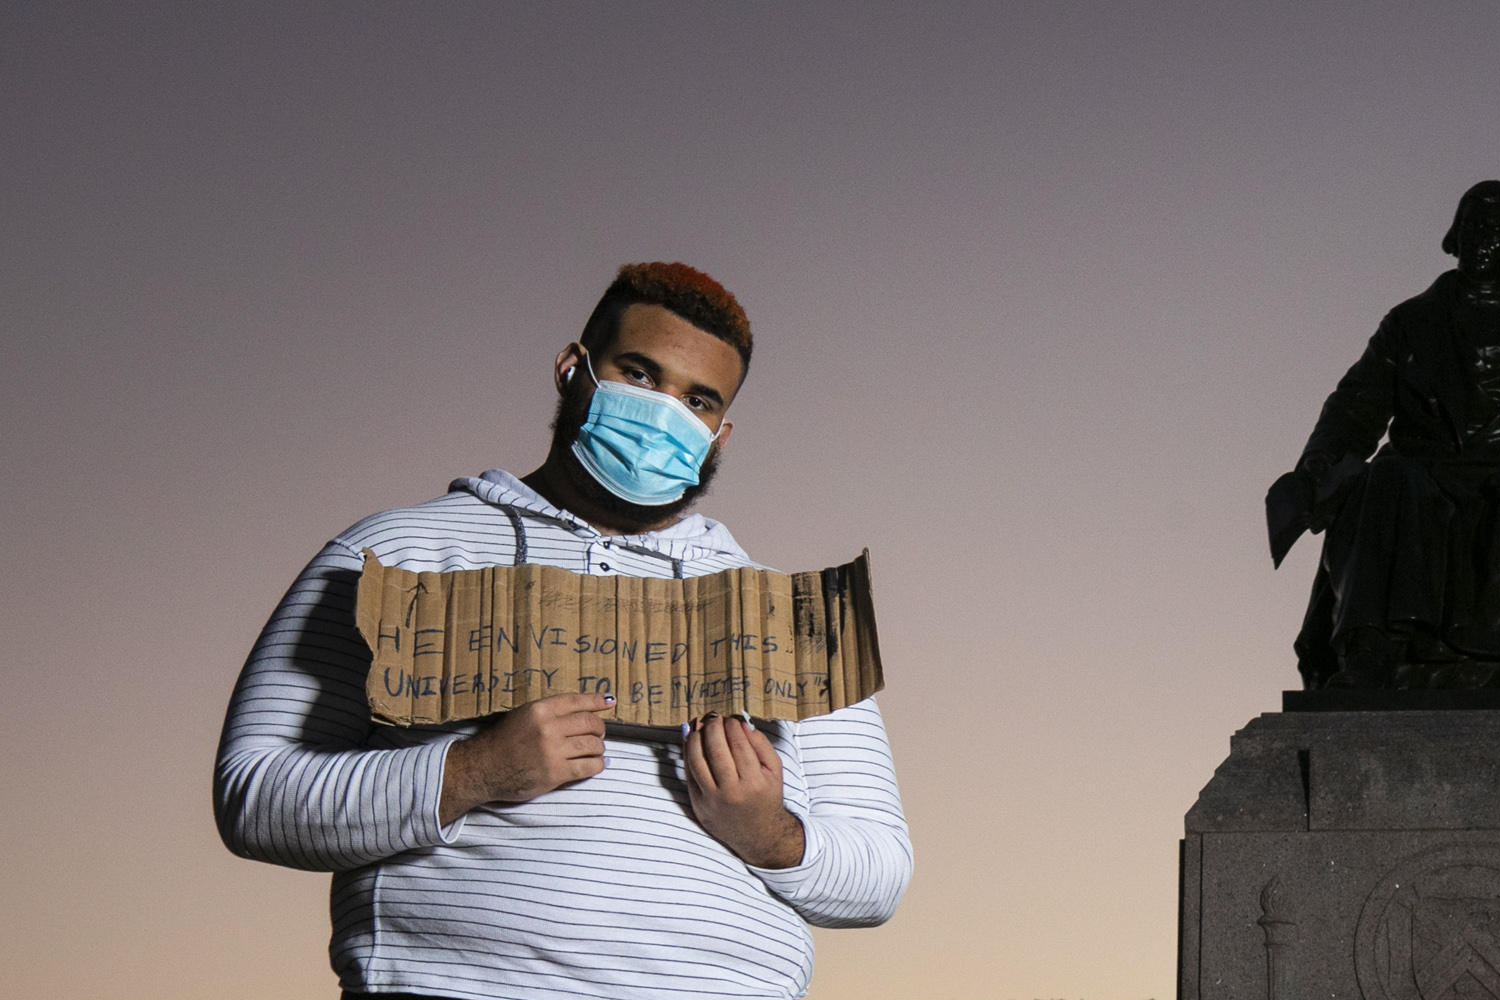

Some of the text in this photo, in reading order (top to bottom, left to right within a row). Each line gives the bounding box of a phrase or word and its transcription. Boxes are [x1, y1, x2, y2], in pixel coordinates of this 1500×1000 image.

[377, 618, 778, 664] HE ENVISIONED THIS
[384, 666, 559, 699] UNIVERSITY
[631, 682, 664, 705] BE
